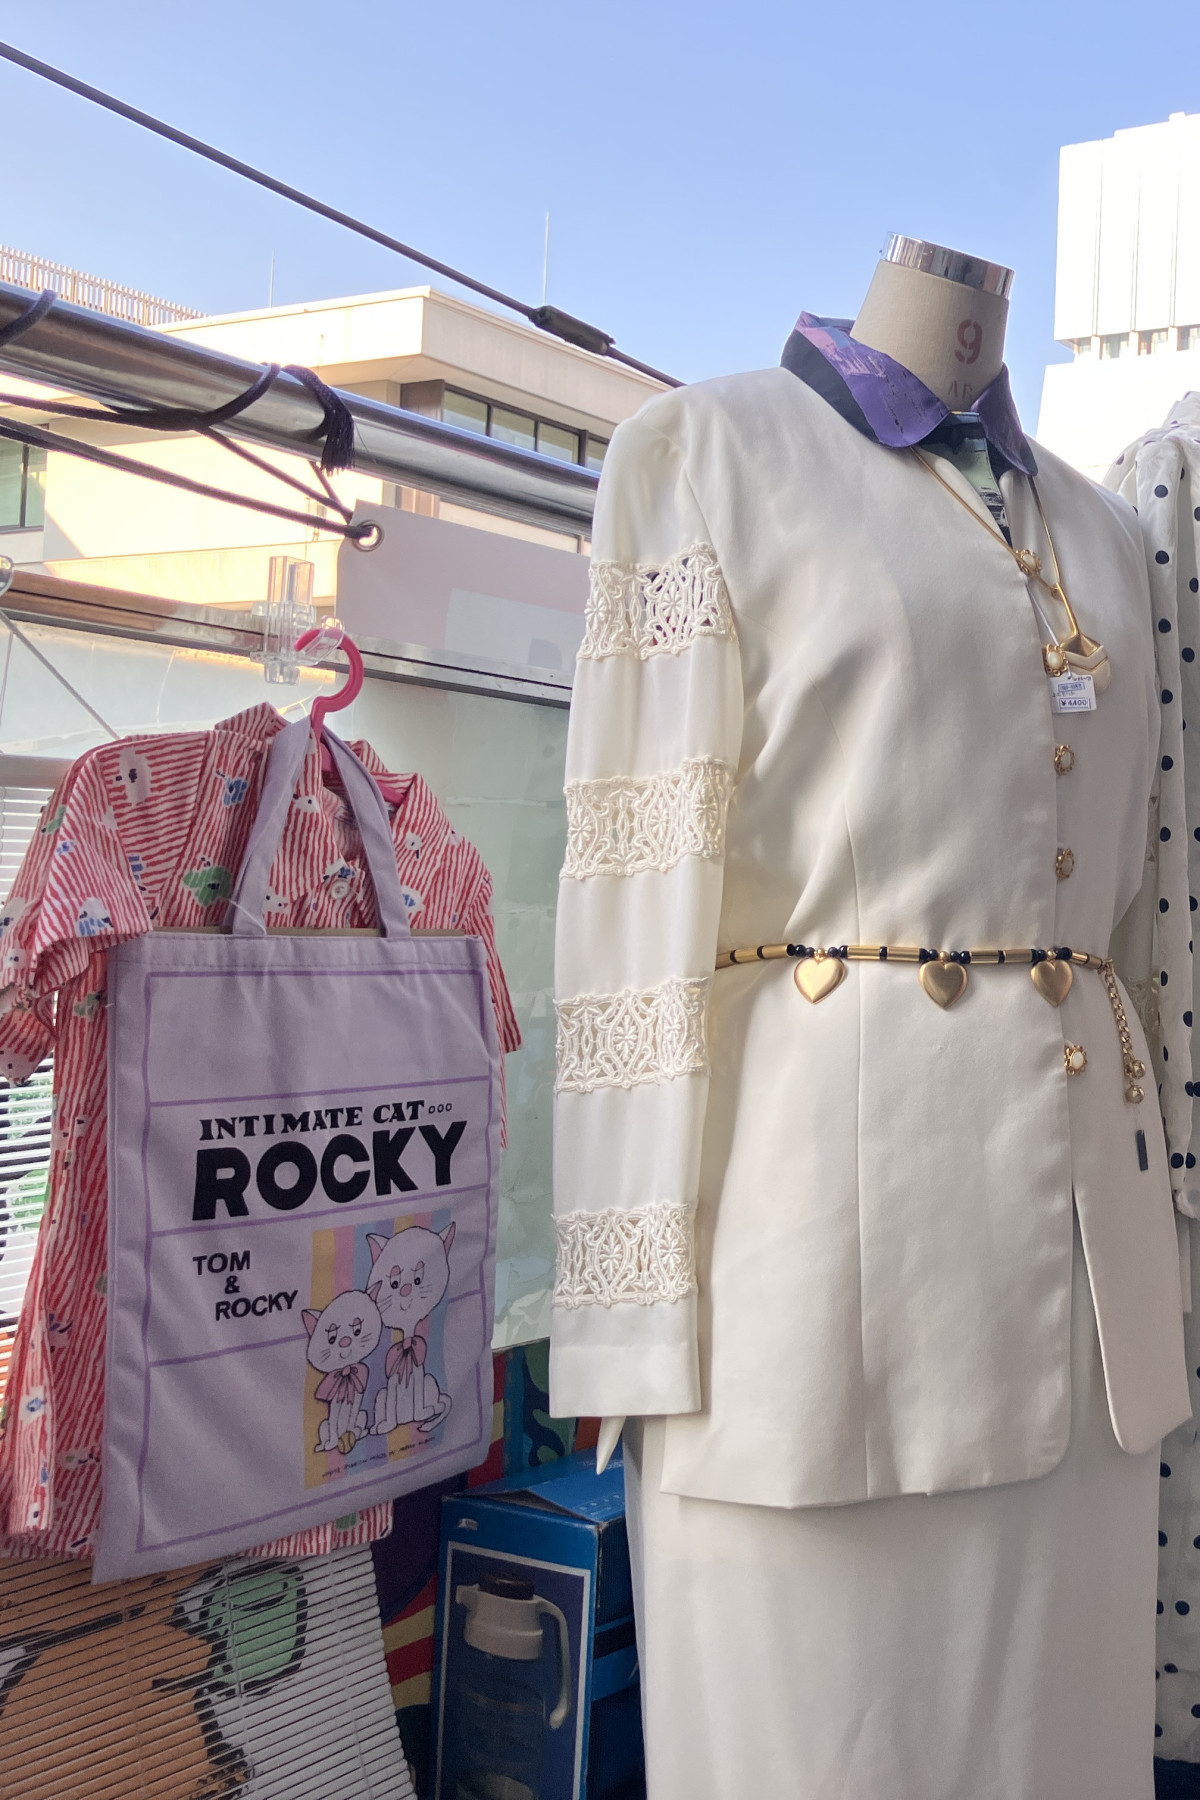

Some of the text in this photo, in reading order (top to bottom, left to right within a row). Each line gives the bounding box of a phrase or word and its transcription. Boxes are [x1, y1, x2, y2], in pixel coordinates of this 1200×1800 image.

[953, 319, 983, 365] 9
[199, 1106, 364, 1141] INTIMATE
[191, 1119, 469, 1222] ROCKY
[192, 1250, 252, 1276] TOM
[223, 1275, 241, 1295] &
[214, 1290, 299, 1322] ROCKY
